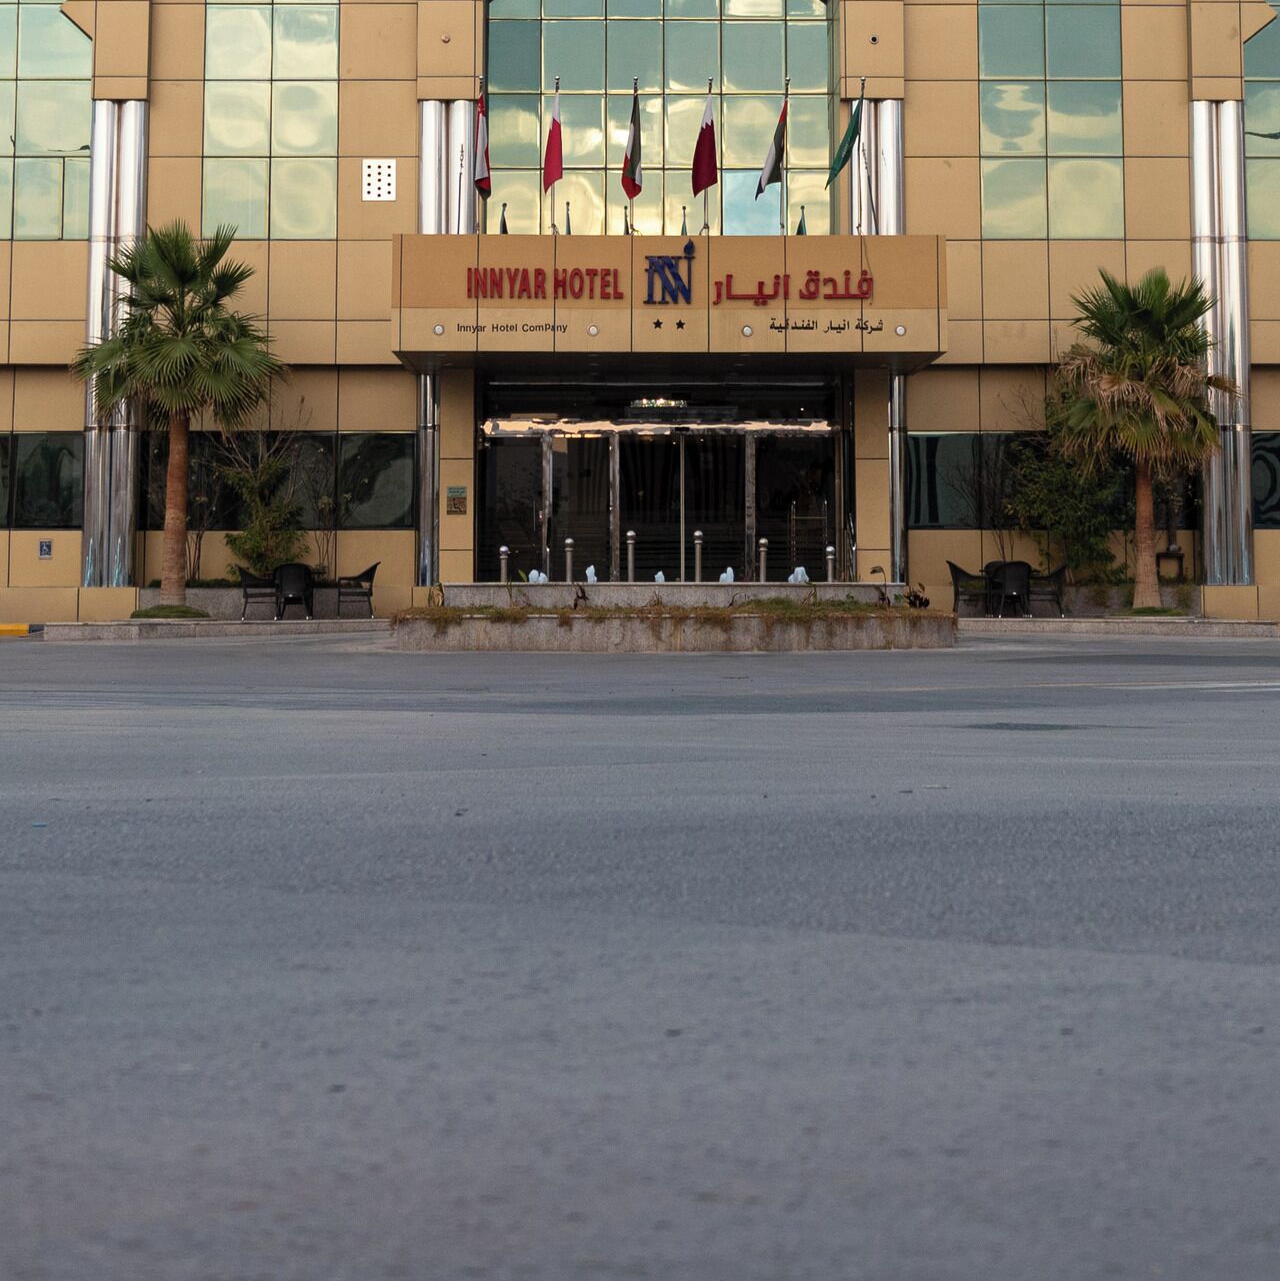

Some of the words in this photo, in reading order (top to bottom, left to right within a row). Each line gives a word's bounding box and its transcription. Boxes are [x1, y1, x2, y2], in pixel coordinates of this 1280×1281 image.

[467, 268, 547, 300] INNYAR
[553, 268, 625, 300] HOTEL
[713, 274, 790, 306] انيار
[799, 270, 874, 300] فندق
[457, 323, 487, 334] Innyar
[491, 323, 518, 333] Hotel
[770, 318, 818, 333] الفندقية
[824, 320, 850, 334] انيار
[855, 318, 884, 334] شركة
